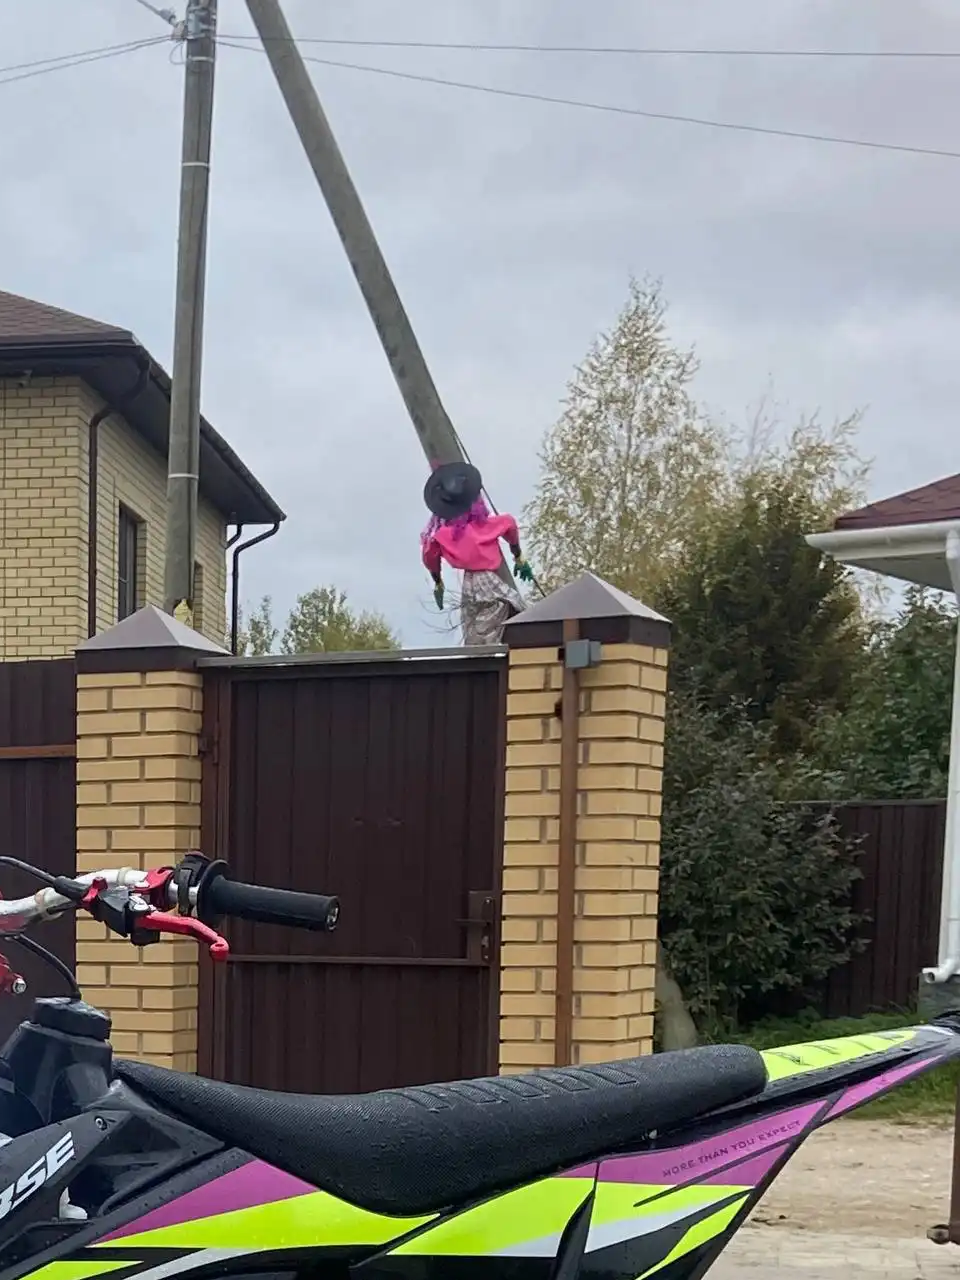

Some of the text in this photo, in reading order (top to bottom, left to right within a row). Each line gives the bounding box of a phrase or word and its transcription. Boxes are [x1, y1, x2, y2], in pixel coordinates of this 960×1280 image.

[662, 1120, 801, 1178] MORE THAN YOU EXPECT
